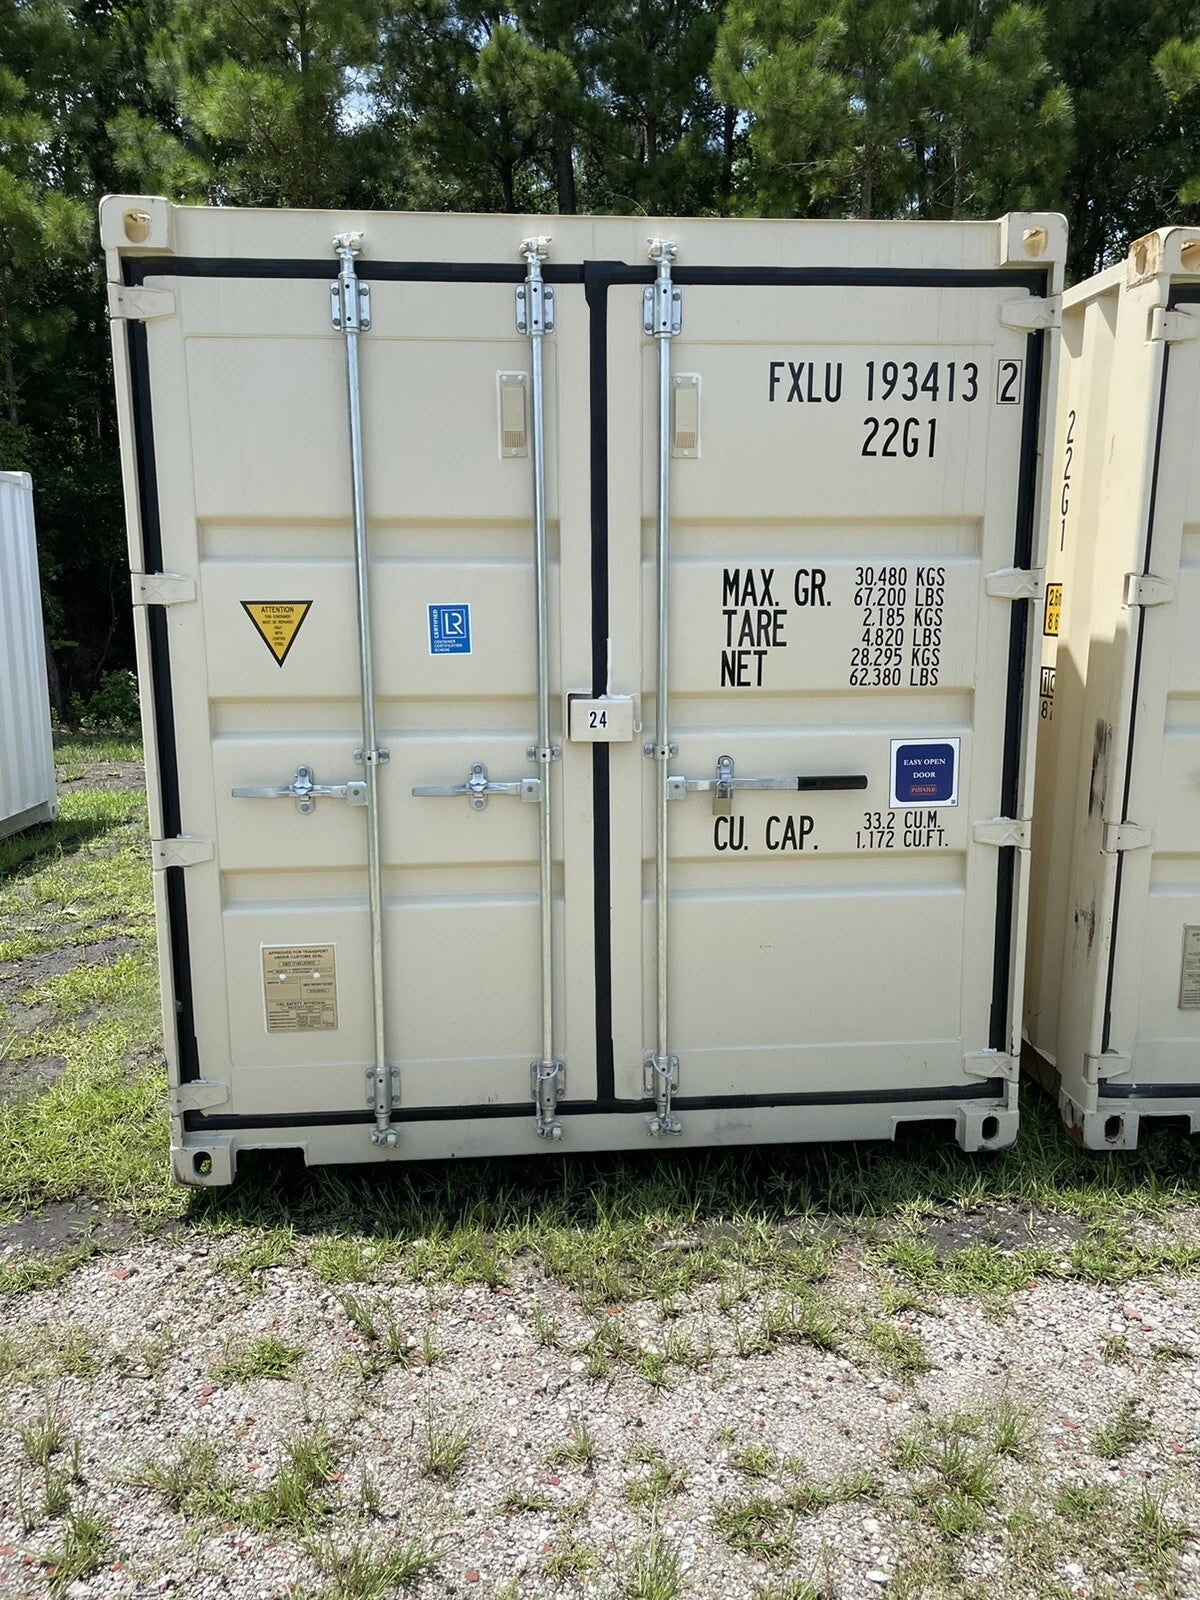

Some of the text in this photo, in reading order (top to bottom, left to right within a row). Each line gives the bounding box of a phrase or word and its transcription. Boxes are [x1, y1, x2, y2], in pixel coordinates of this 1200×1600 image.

[769, 361, 1020, 403] FXLU 193413 2
[861, 417, 937, 458] 22G1
[722, 567, 945, 607] MAX. GR. 30,480 KGS
[854, 587, 944, 606] 67,200 LBS
[445, 612, 464, 635] LR
[722, 607, 943, 647] TARE 2,185 KGS
[862, 628, 942, 647] 4,820 LBS
[721, 648, 940, 687] NET 28,295 KGS
[850, 668, 939, 686] 62,380 LBS
[590, 711, 607, 728] 24
[714, 810, 941, 850] CU. CAP. 33.2 CU.M.
[903, 829, 948, 848] CU.FT.
